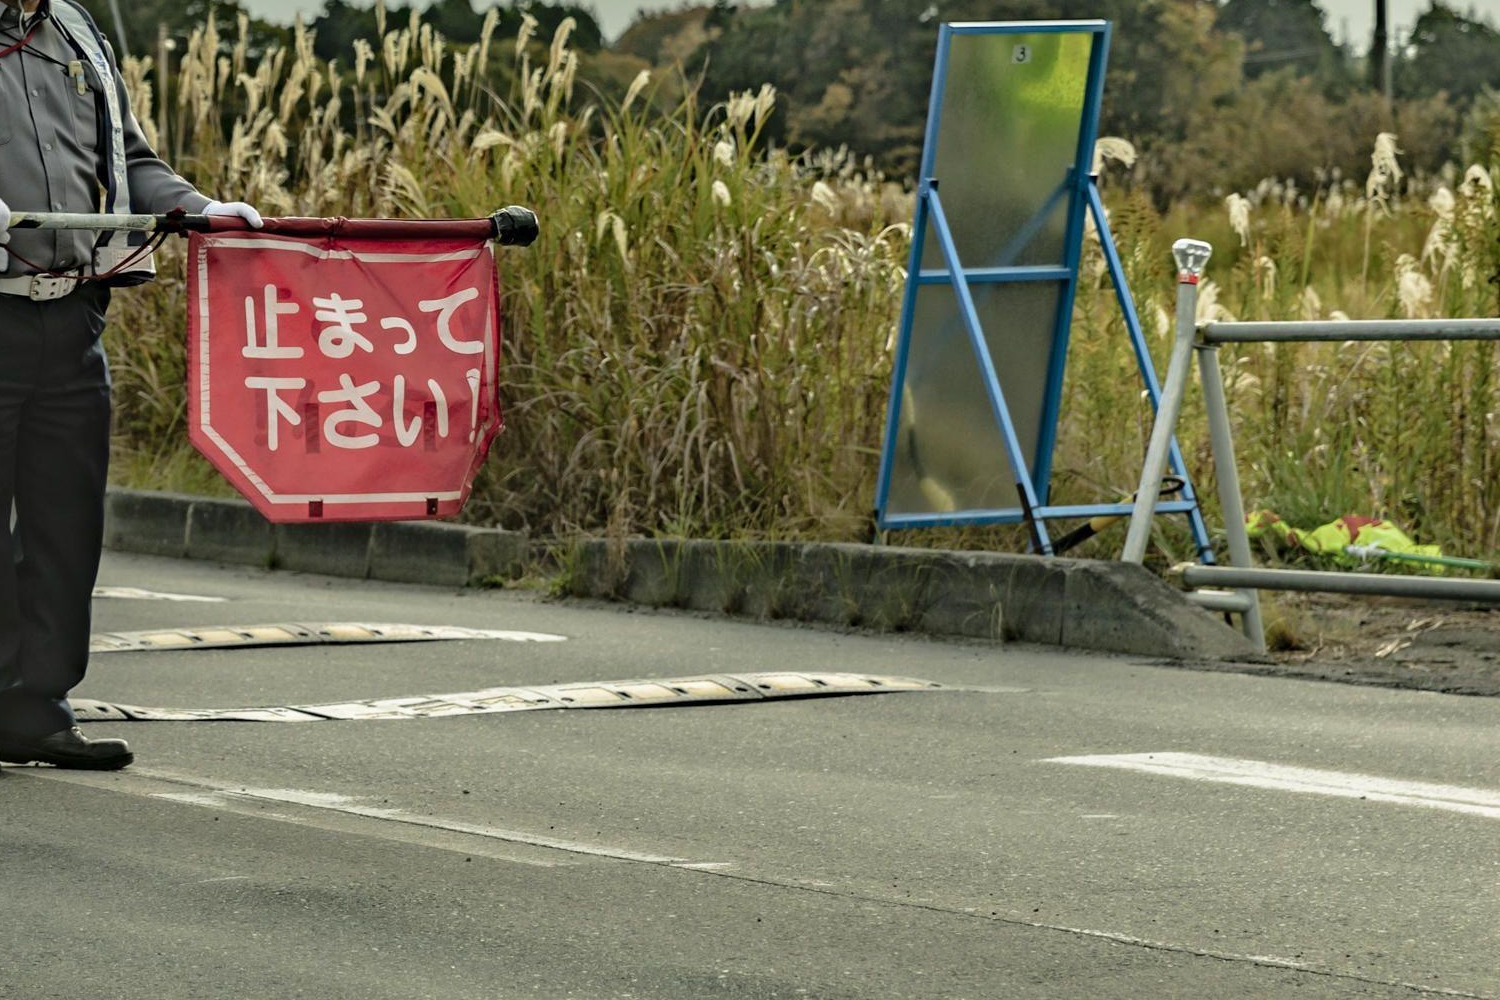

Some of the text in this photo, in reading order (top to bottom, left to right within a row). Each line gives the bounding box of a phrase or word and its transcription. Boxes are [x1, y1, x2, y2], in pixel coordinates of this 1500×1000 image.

[1015, 47, 1026, 62] 3
[241, 283, 484, 359] 止まって
[244, 367, 481, 452] 下さい!
